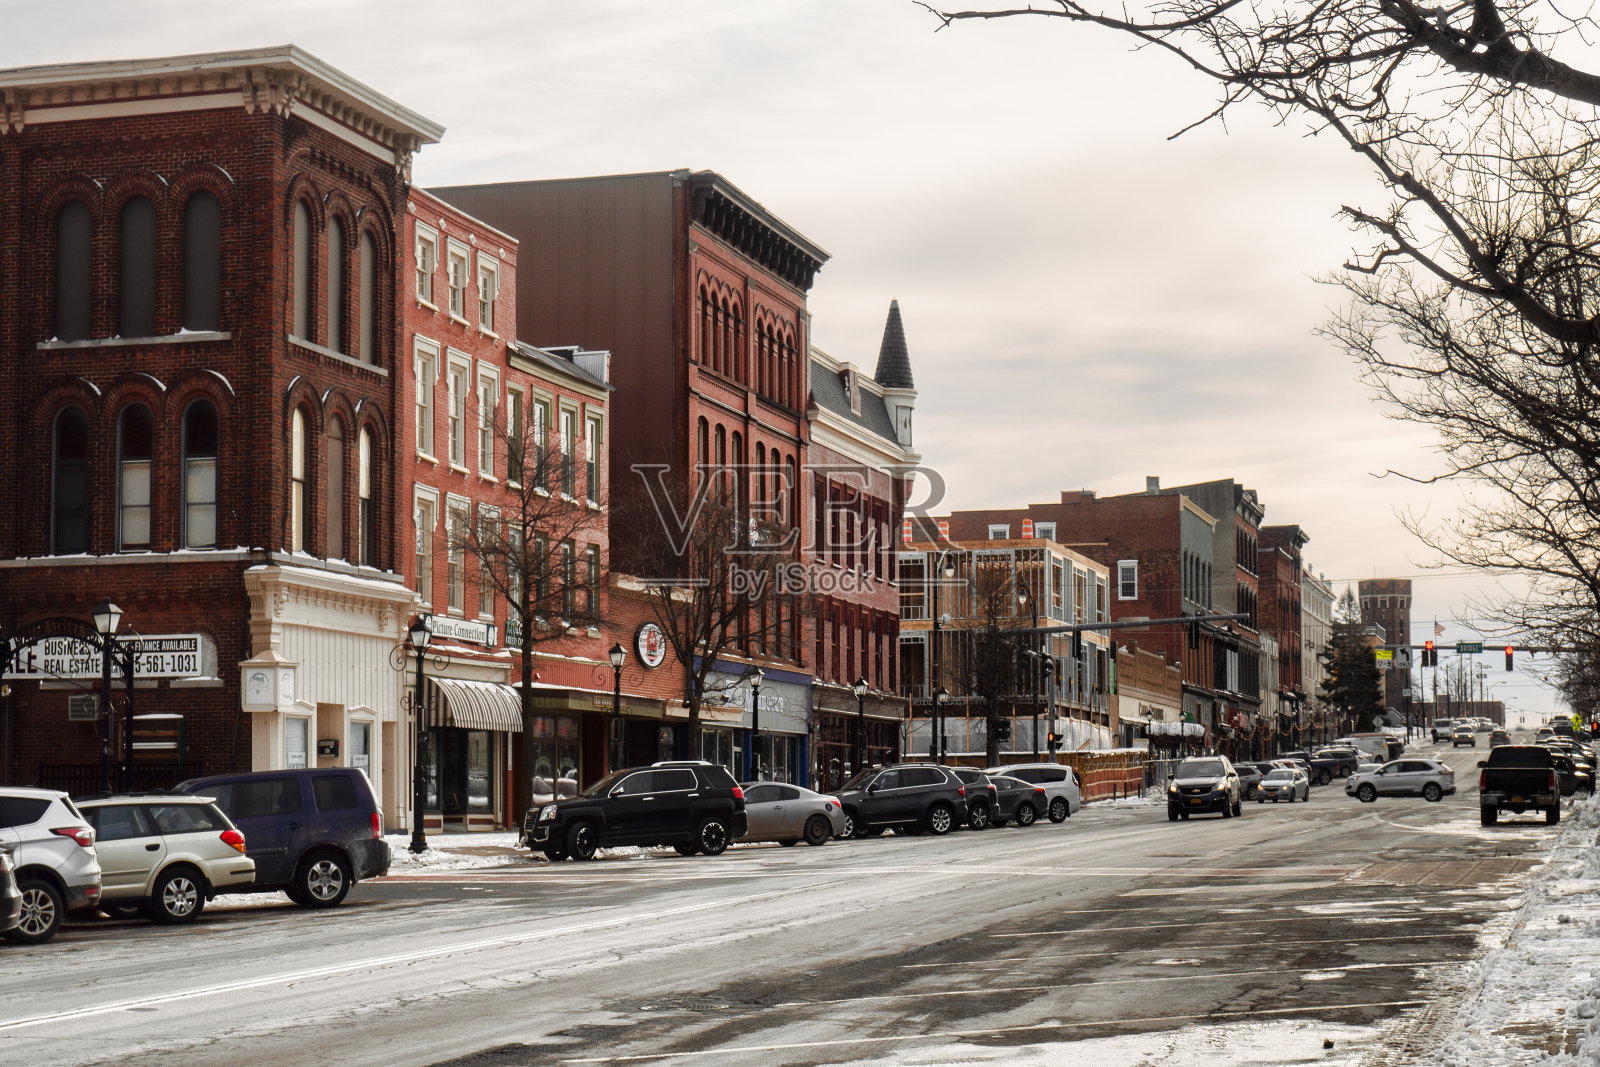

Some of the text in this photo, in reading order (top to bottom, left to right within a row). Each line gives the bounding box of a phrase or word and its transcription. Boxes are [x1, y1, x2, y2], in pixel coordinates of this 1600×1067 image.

[433, 621, 453, 636] Picture
[453, 623, 486, 642] Connection
[161, 639, 196, 651] AVAILABLE
[1460, 644, 1479, 652] BRIDGE
[44, 658, 66, 674] REAL
[69, 658, 101, 674] ESTATE
